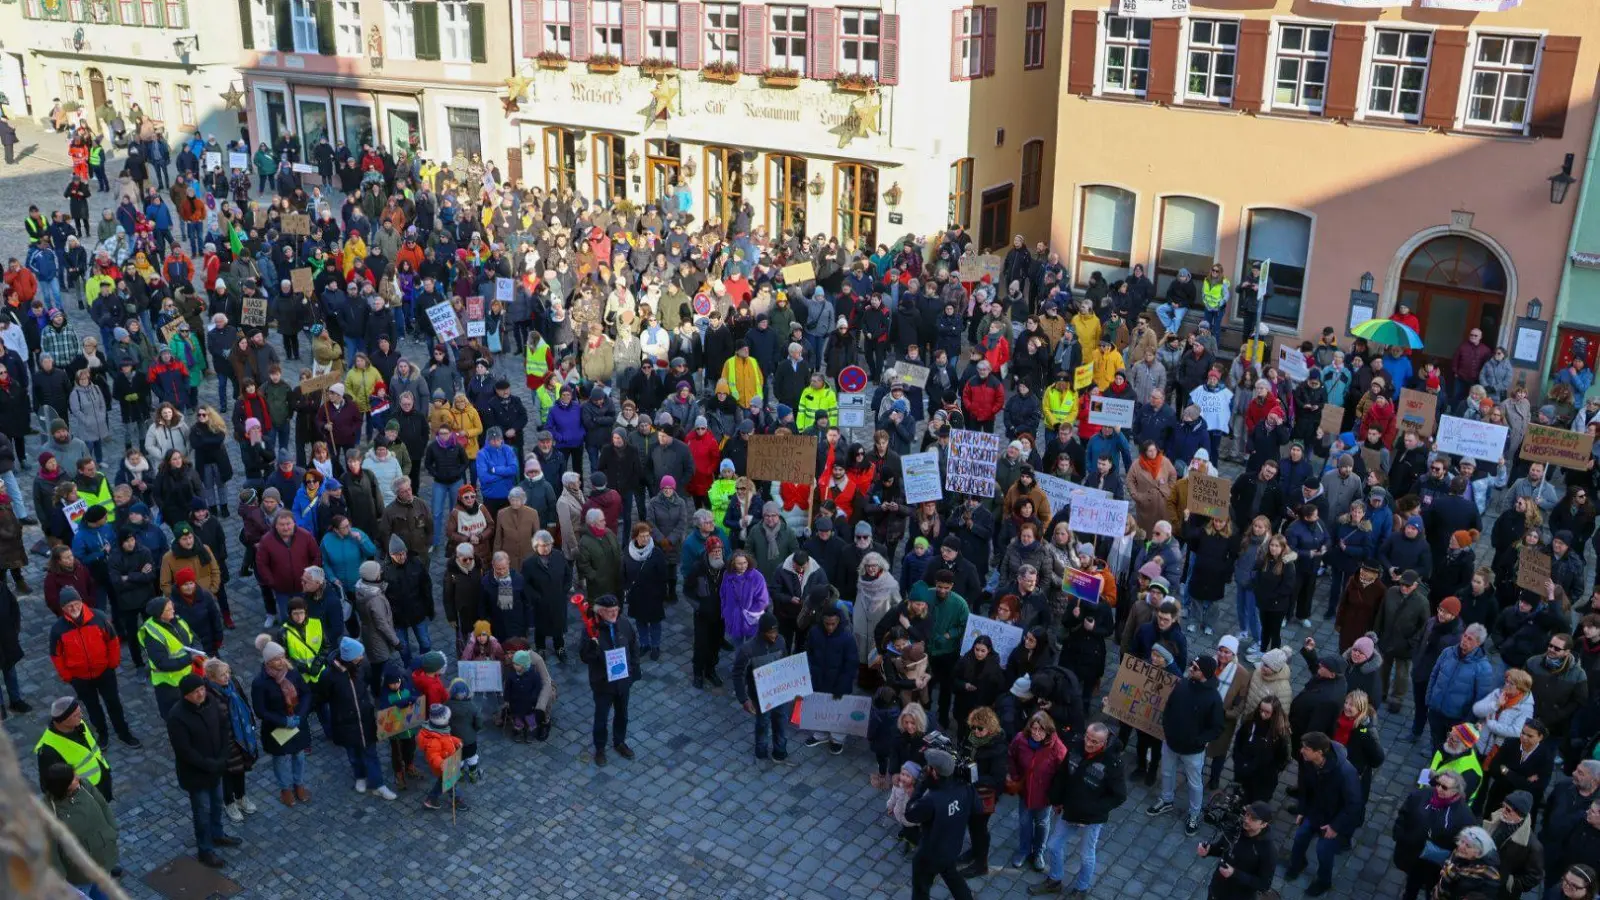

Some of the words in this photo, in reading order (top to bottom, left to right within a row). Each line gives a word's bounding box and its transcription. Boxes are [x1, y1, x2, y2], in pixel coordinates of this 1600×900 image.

[743, 101, 800, 122] Restaurant
[1193, 475, 1218, 489] NAZIS
[1193, 485, 1219, 497] ESSEN
[948, 799, 961, 816] BR
